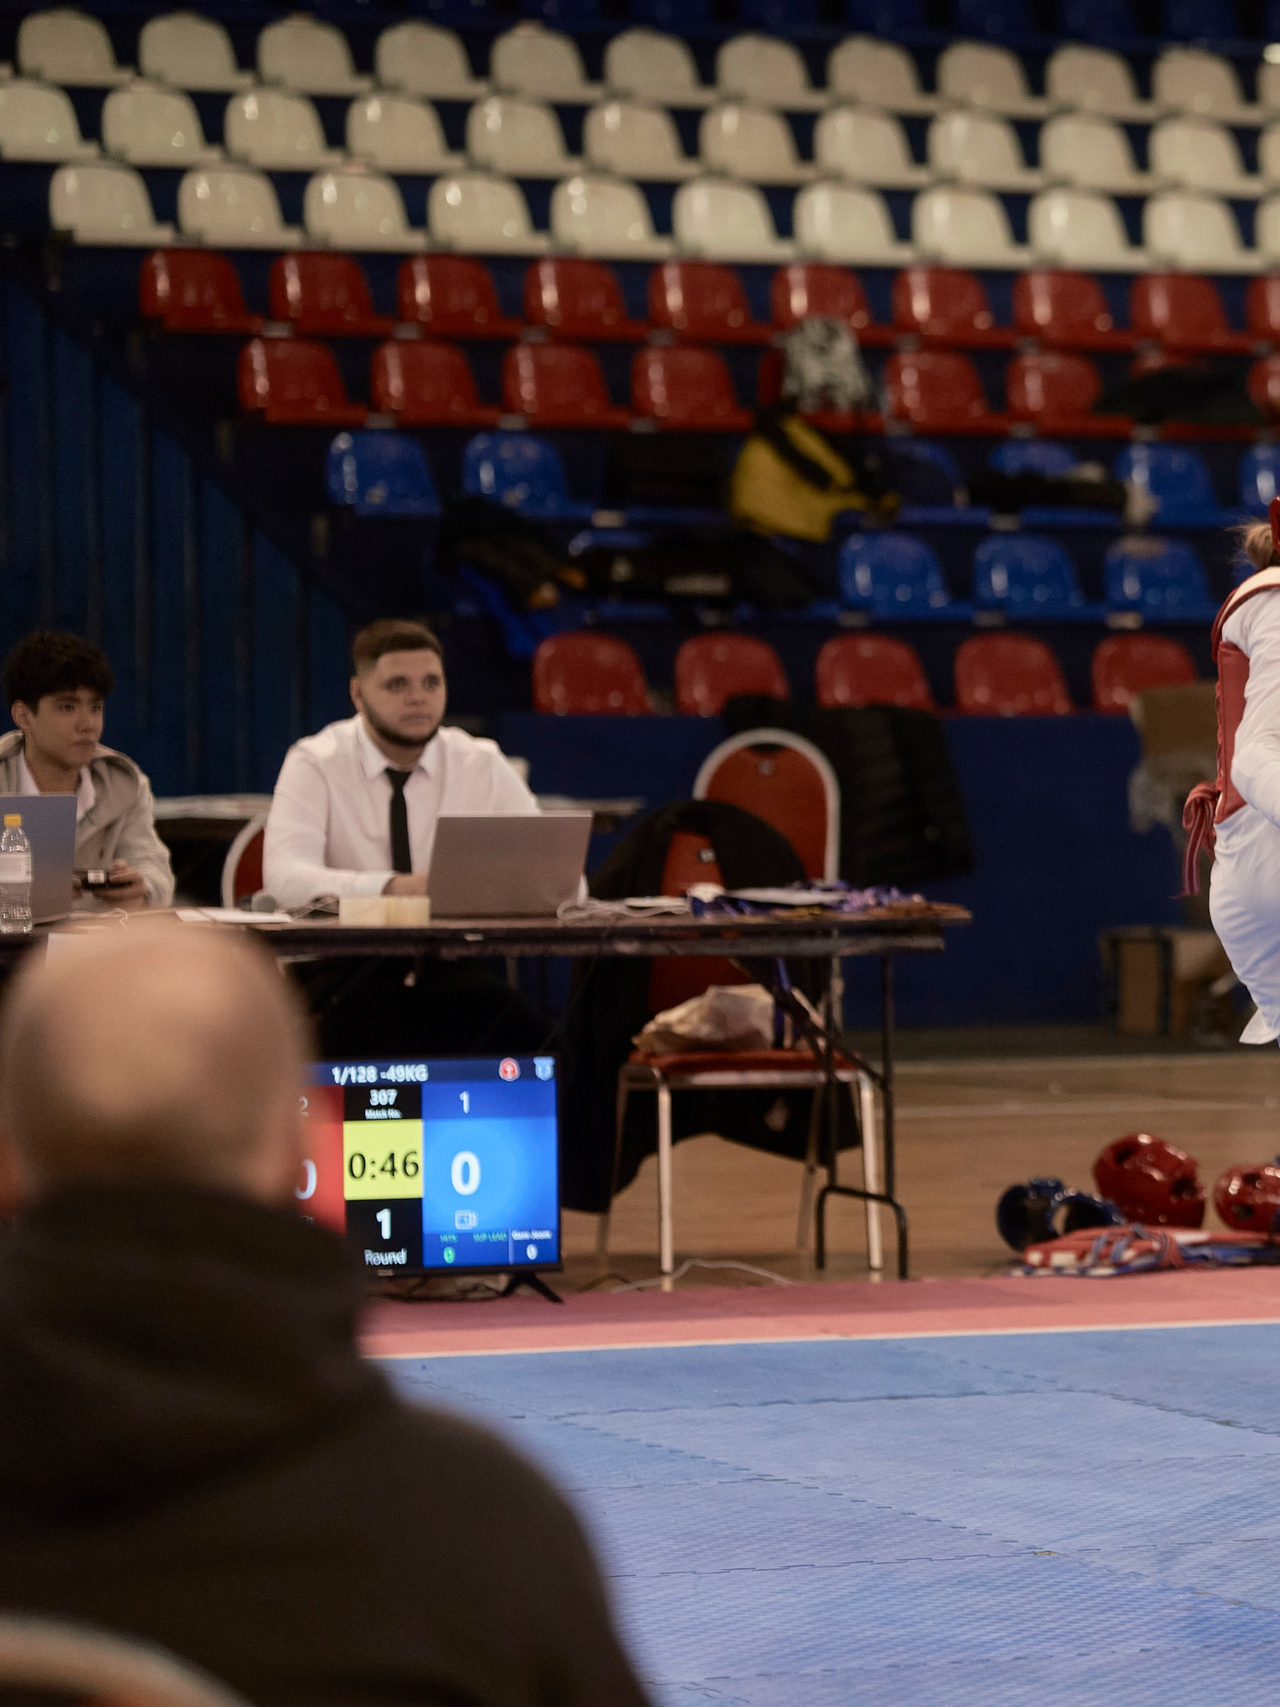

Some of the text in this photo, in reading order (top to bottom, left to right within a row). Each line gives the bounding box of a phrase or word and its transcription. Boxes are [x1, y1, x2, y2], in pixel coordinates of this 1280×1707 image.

[332, 1064, 429, 1086] 1/128 -49KG
[369, 1089, 398, 1106] 307
[459, 1091, 470, 1114] 1
[348, 1150, 420, 1180] 0:46
[451, 1150, 481, 1196] 0
[376, 1208, 391, 1240] 1
[364, 1248, 408, 1266] Round
